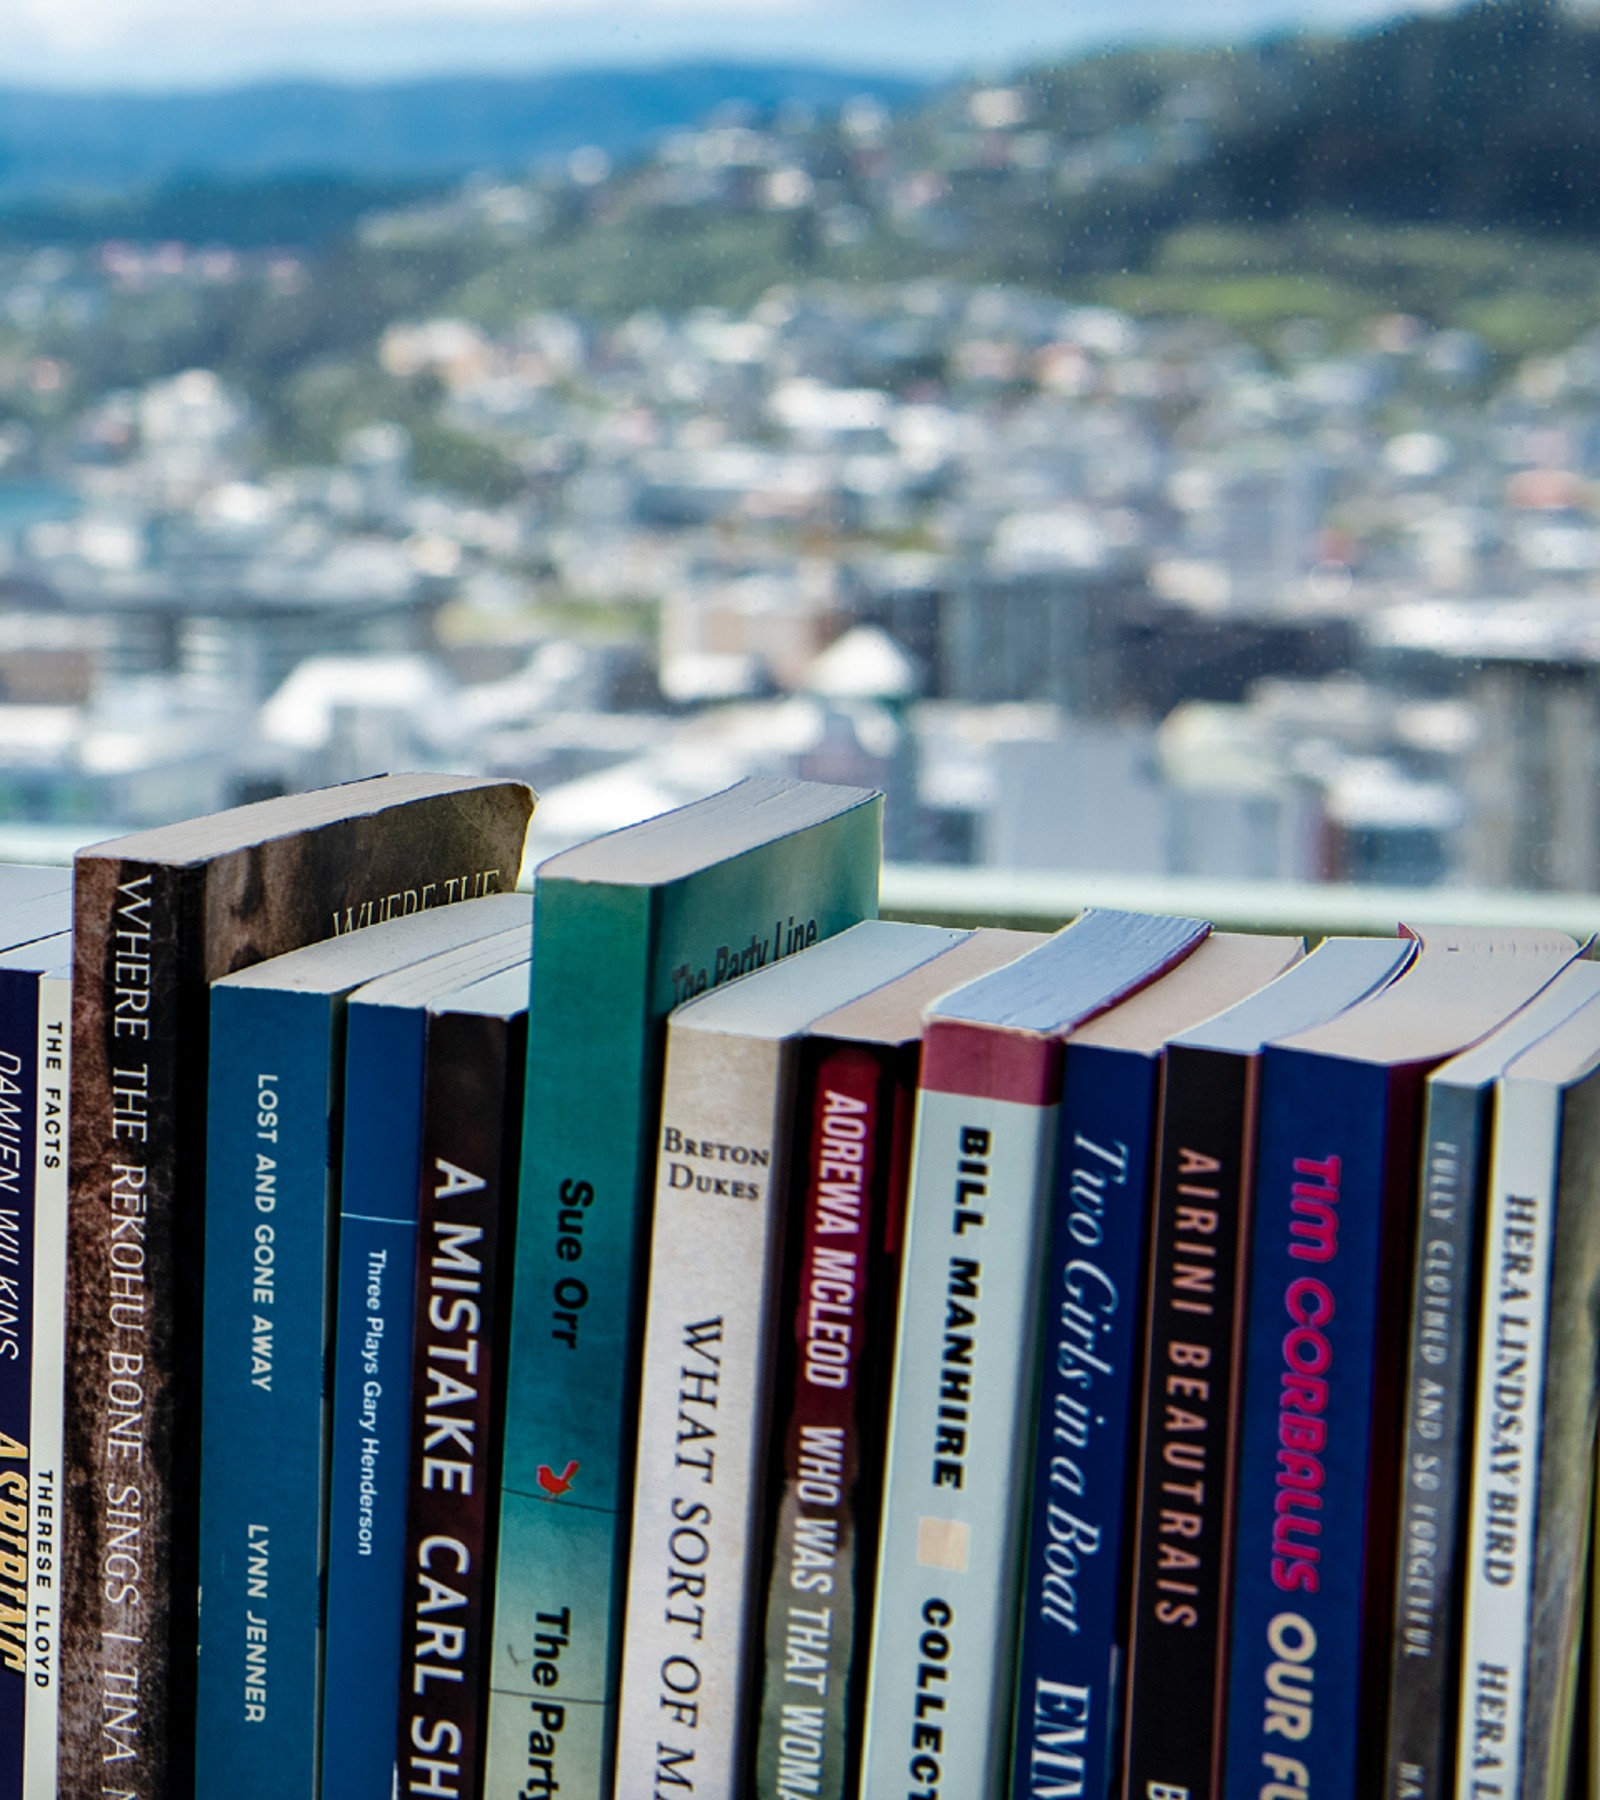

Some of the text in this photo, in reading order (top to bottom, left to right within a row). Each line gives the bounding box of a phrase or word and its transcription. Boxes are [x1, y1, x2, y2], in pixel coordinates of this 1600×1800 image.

[114, 874, 153, 1041] WHERE
[111, 1063, 149, 1143] THE
[663, 1126, 771, 1168] BRETON
[668, 1162, 760, 1202] DUKES
[815, 1089, 868, 1234] AOREWA
[952, 1125, 991, 1237] BILL
[1066, 1131, 1128, 1247] Two
[1287, 1154, 1341, 1264] TIM
[557, 1178, 595, 1262] Sue
[1170, 1147, 1221, 1316] AIRINI
[1501, 1193, 1538, 1304] HERA
[34, 1021, 63, 1688] THE FACTS THERESE LLOYD
[551, 1278, 589, 1350] Orr
[805, 1246, 859, 1390] MCLEOD
[1057, 1259, 1119, 1390] Girls
[106, 1350, 144, 1464] BONE
[244, 1074, 279, 1723] LOST AND GONE AWAY LYNN JENNER
[357, 1249, 388, 1556] Three Plays Gary Henderson
[674, 1315, 725, 1484] WHAT
[932, 1256, 981, 1490] MANHIRE
[1053, 1394, 1106, 1450] in
[1414, 1376, 1446, 1441] AND
[1488, 1312, 1531, 1487] LINDSAY
[408, 1158, 487, 1800] A MISTAKE CARL SH
[797, 1425, 845, 1506] WHO
[1048, 1455, 1085, 1497] a
[1154, 1340, 1211, 1628] BEAUTRAIS
[1270, 1276, 1336, 1594] CORBALLIS
[1411, 1452, 1442, 1492] SO
[104, 1482, 142, 1606] SINGS
[665, 1498, 712, 1640] SORT
[790, 1518, 838, 1597] WAS
[1040, 1498, 1102, 1636] Boat
[1481, 1489, 1520, 1590] BIRD
[531, 1607, 570, 1688] The
[659, 1655, 702, 1730] OF
[784, 1606, 832, 1696] THAT
[1261, 1611, 1317, 1742] OUR
[101, 1668, 140, 1763] TINA
[1472, 1660, 1509, 1773] HERA
